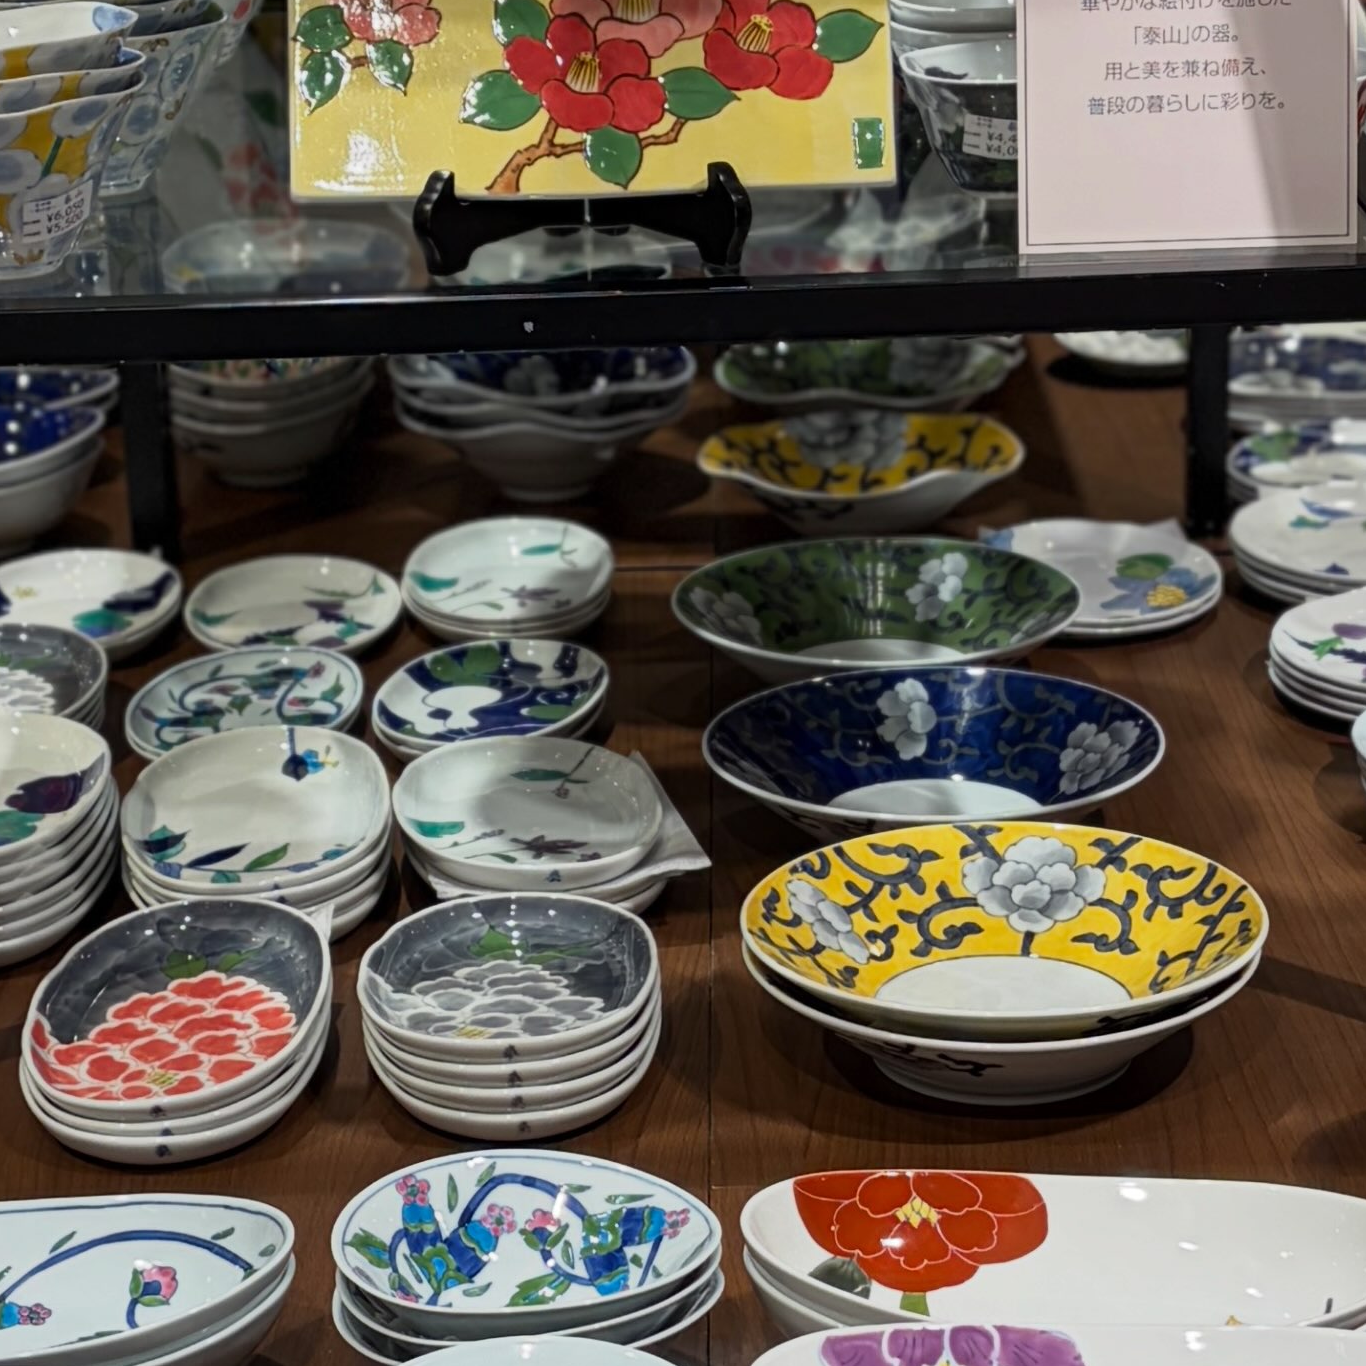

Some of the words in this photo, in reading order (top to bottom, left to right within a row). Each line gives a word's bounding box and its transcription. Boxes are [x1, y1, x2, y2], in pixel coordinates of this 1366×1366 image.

[1134, 23, 1239, 46] 「泰山」の器。
[1104, 56, 1266, 81] 用と美を兼ね備え、
[1087, 91, 1285, 116] 普段の暮らしに彩りを。
